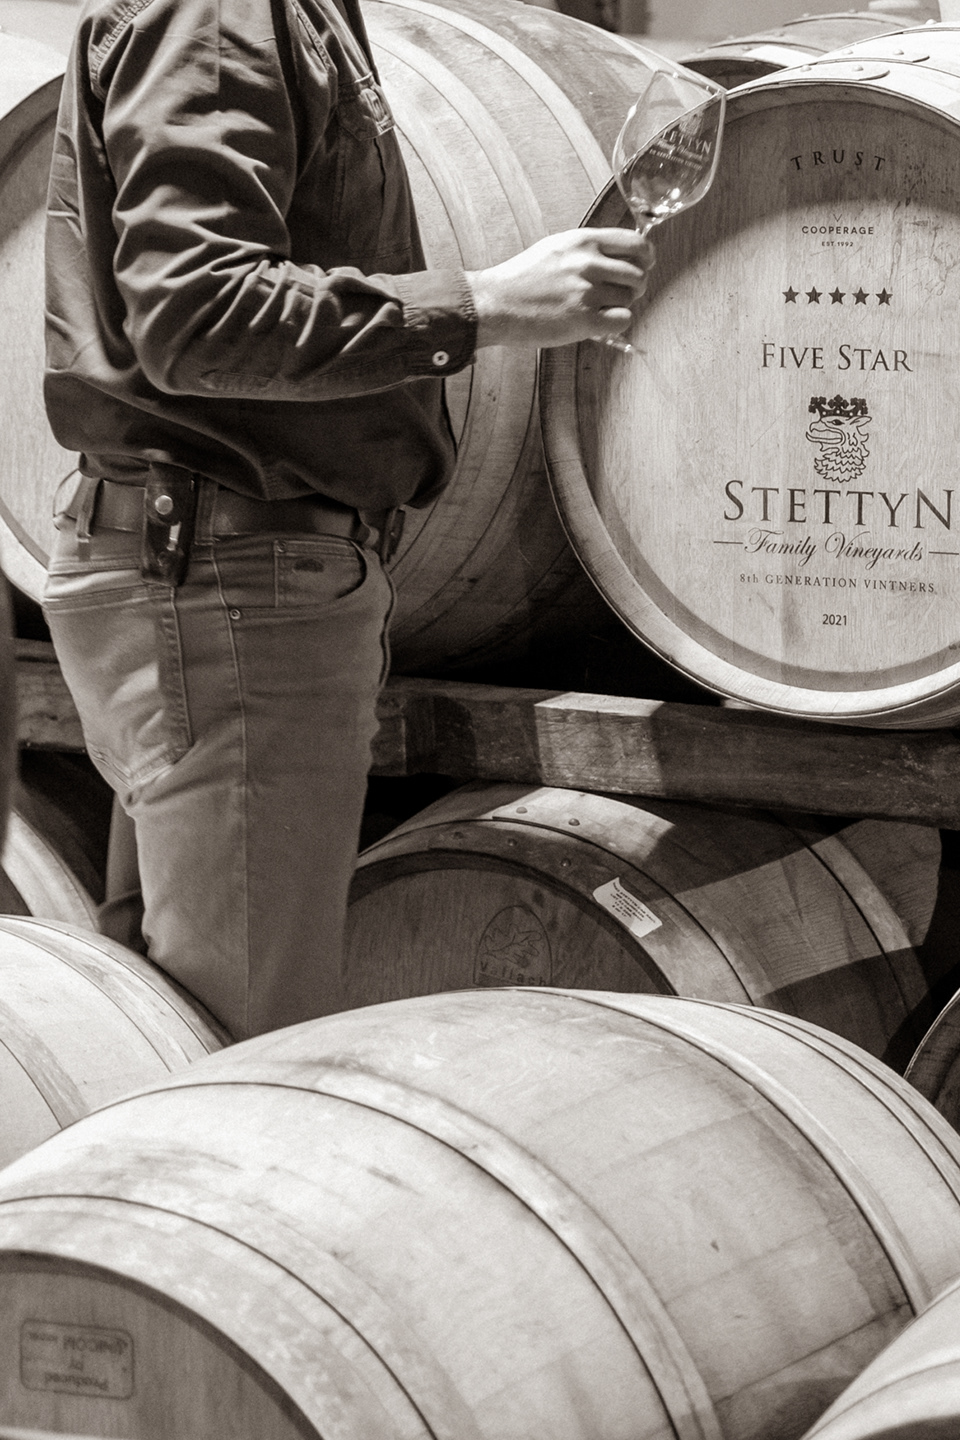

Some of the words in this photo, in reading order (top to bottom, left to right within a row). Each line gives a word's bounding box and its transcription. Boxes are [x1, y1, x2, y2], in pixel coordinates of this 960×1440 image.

[790, 149, 886, 172] TRUST
[801, 225, 875, 235] COOPERAGE
[761, 342, 825, 370] FIVE
[837, 344, 914, 372] STAR
[723, 479, 955, 531] STETTYN
[744, 527, 817, 567] Family
[824, 530, 923, 570] Vineyards
[739, 574, 759, 584] 8th
[765, 574, 858, 588] GENERATION
[864, 579, 935, 593] VINTNERS
[822, 613, 848, 626] 2021
